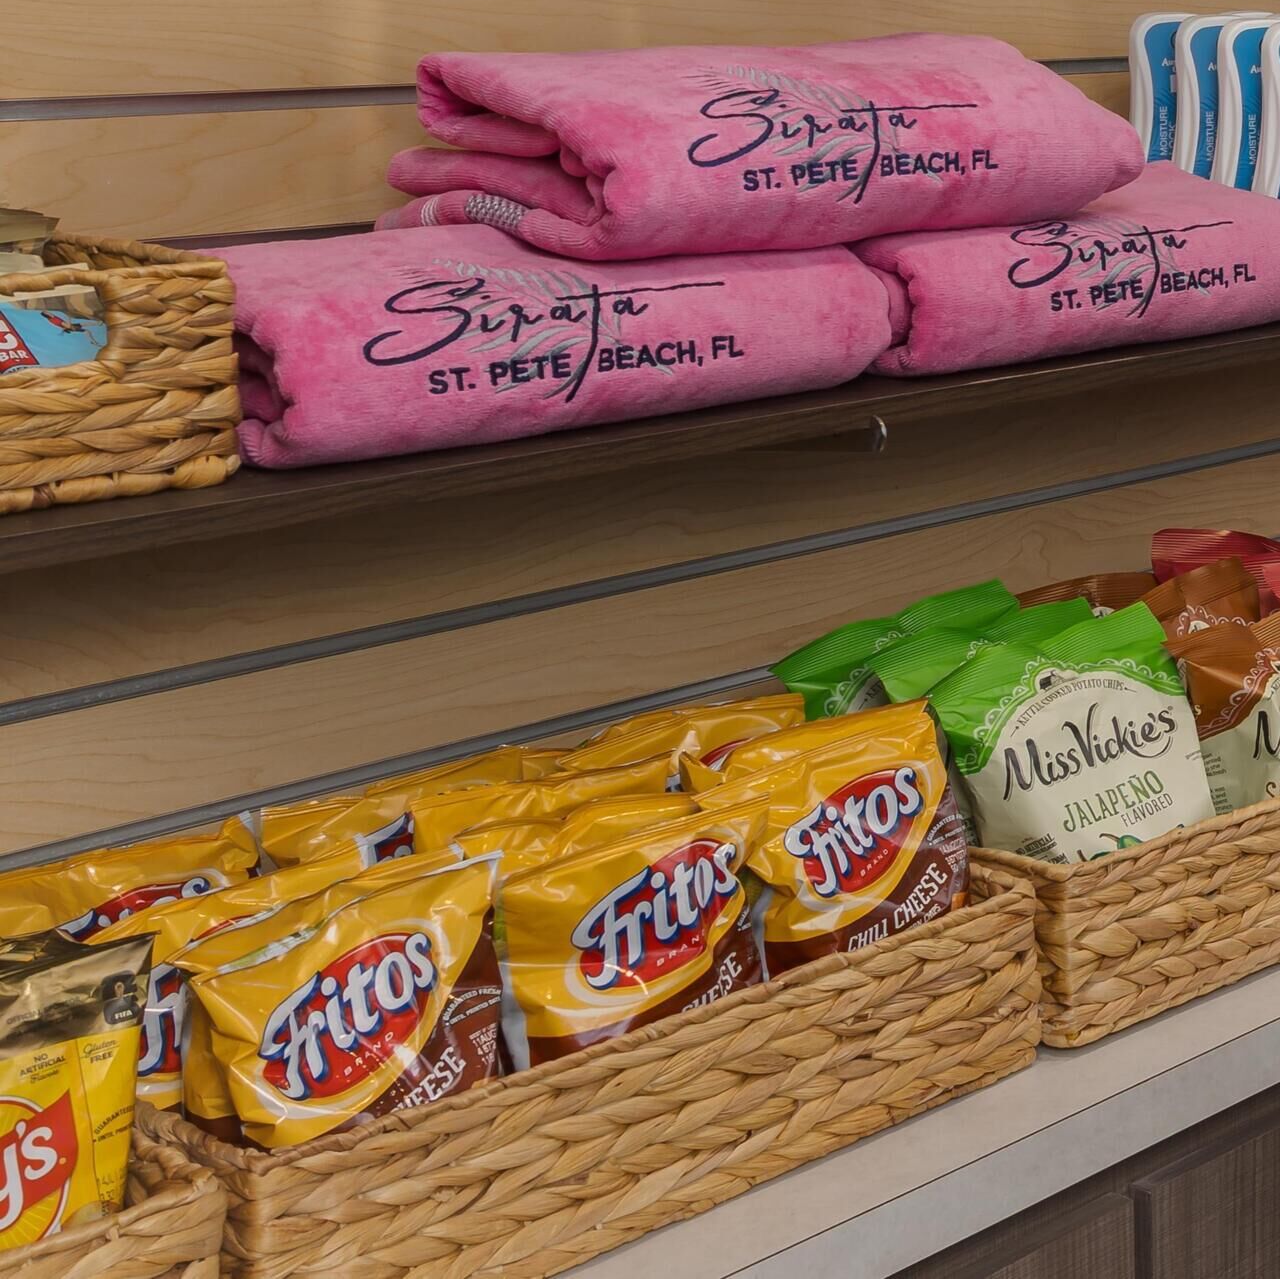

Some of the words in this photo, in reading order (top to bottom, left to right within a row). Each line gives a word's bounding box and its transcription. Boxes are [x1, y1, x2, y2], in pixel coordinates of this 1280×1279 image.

[742, 168, 783, 192] ST.
[791, 160, 858, 186] PETE
[880, 152, 967, 178] BEACH,
[969, 150, 999, 171] FL
[1050, 290, 1082, 312] ST.
[1090, 282, 1145, 307] PETE
[1160, 268, 1229, 295] BEACH,
[1233, 263, 1256, 284] FL
[427, 365, 478, 395] ST.
[488, 353, 572, 385] PETE
[597, 339, 704, 372] BEACH,
[711, 336, 744, 360] FL
[1017, 701, 1041, 726] KETTLE
[1041, 684, 1073, 706] COOKED
[1073, 678, 1101, 691] POTATO
[1103, 678, 1124, 691] CHIPS
[1003, 738, 1081, 801] Miss
[1062, 702, 1176, 768] Vickie's
[1063, 770, 1164, 832] JALAPEÑO
[1121, 793, 1173, 827] FLAVORED
[785, 767, 923, 898] Fritos
[860, 848, 890, 878] BRAND
[571, 844, 739, 991] Fritos
[847, 919, 889, 952] CHILI
[894, 862, 948, 930] CHEESE
[115, 1010, 132, 1019] FIFA
[260, 932, 438, 1099] Fritos
[20, 1055, 66, 1076] ARTIFICIAL
[34, 1053, 48, 1062] NO
[83, 1040, 118, 1056] Gluten
[90, 1051, 113, 1063] FREE
[344, 1031, 395, 1076] BRAND
